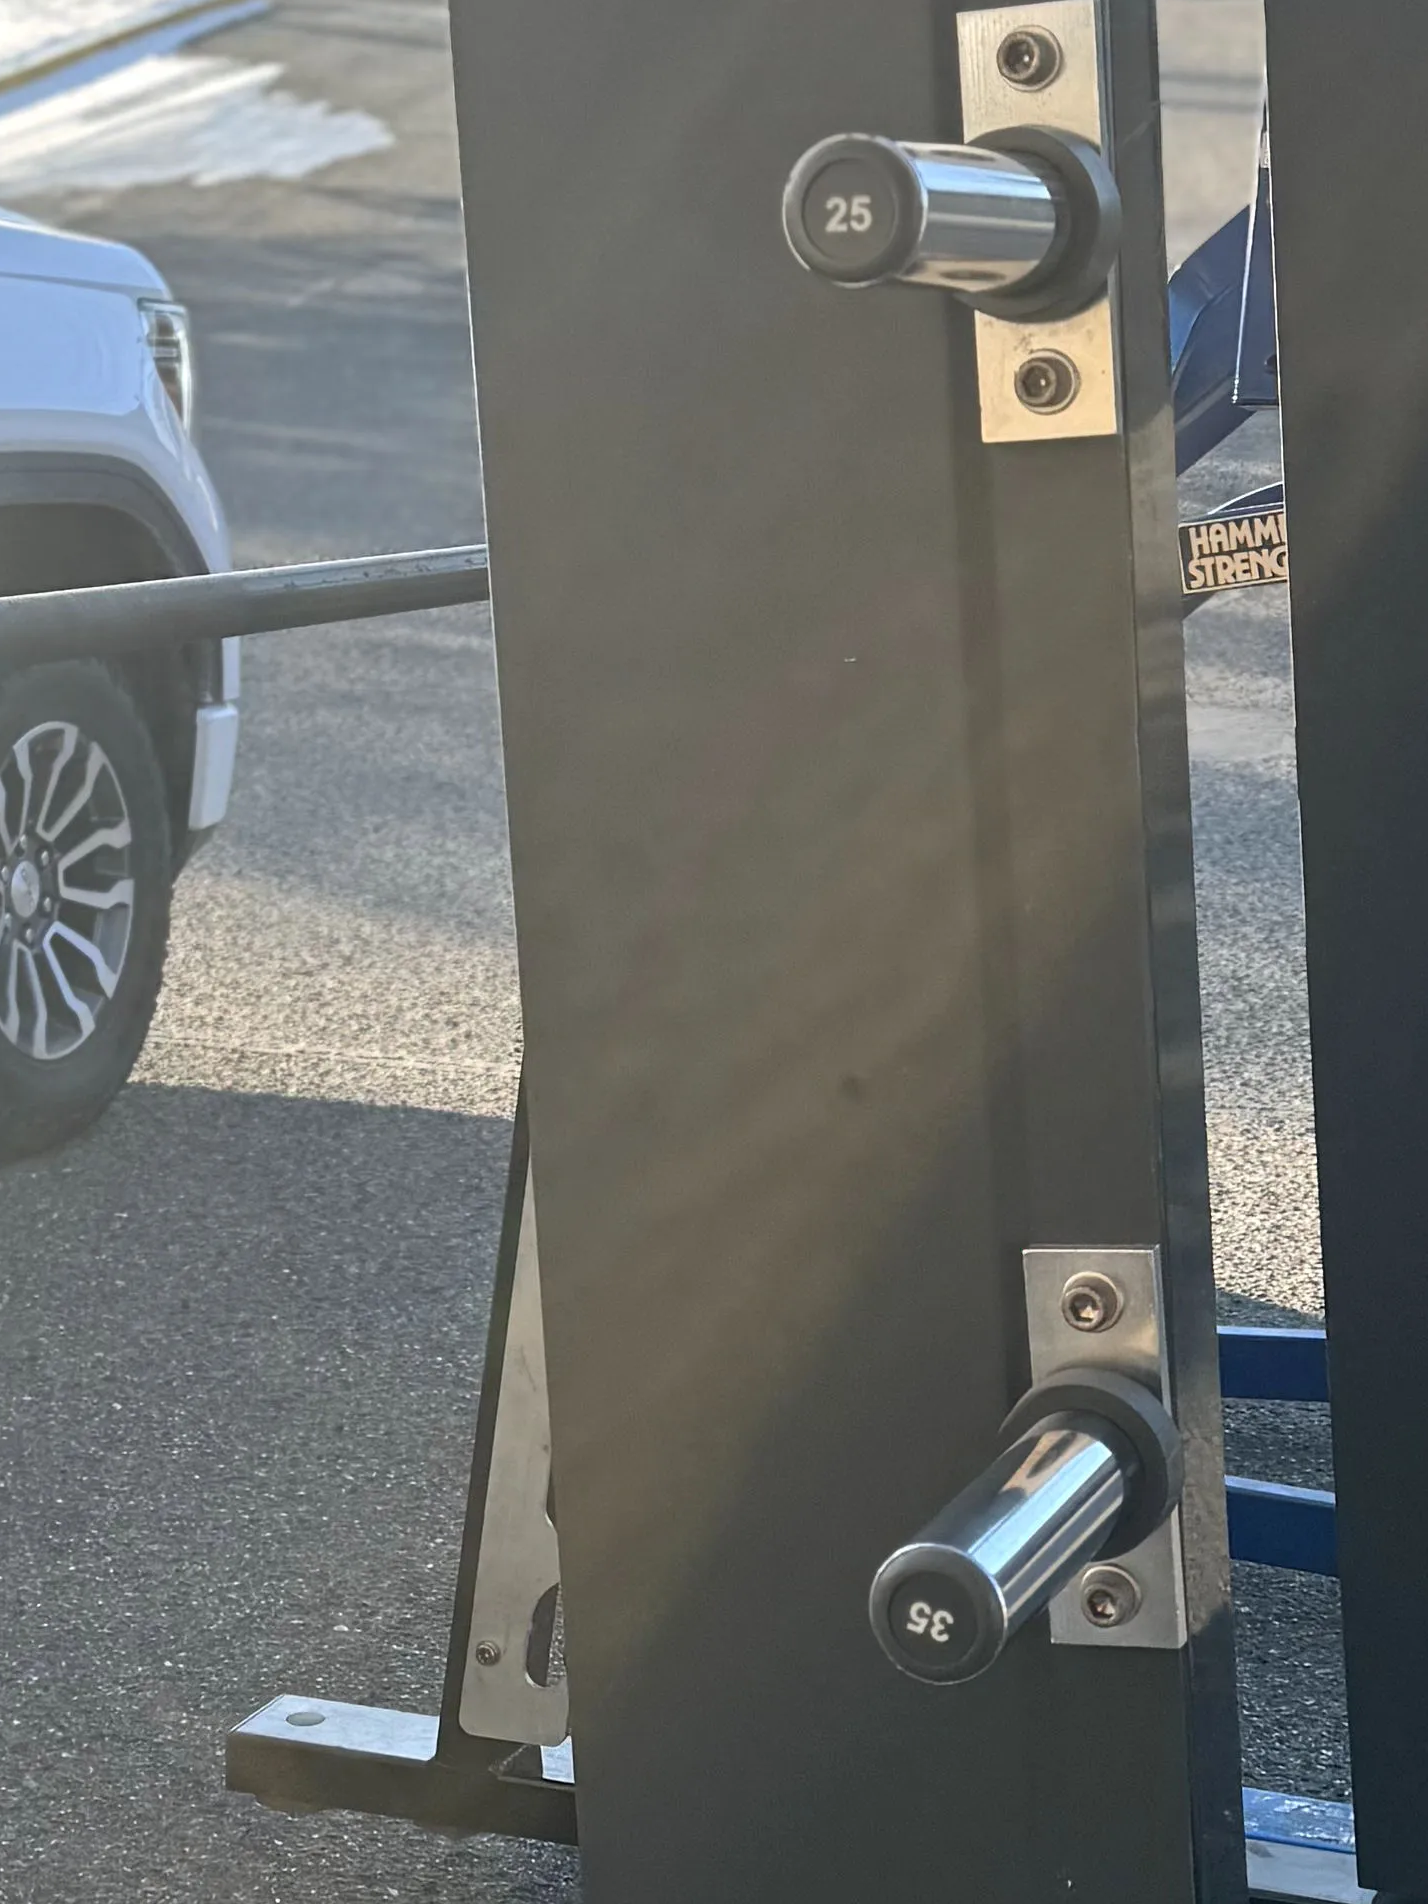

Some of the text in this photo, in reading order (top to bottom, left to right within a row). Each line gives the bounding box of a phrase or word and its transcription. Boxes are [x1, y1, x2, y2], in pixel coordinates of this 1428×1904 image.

[824, 195, 873, 233] 25
[1188, 515, 1287, 559] HAMM
[1188, 548, 1288, 589] STRENG
[905, 1600, 955, 1643] 35
